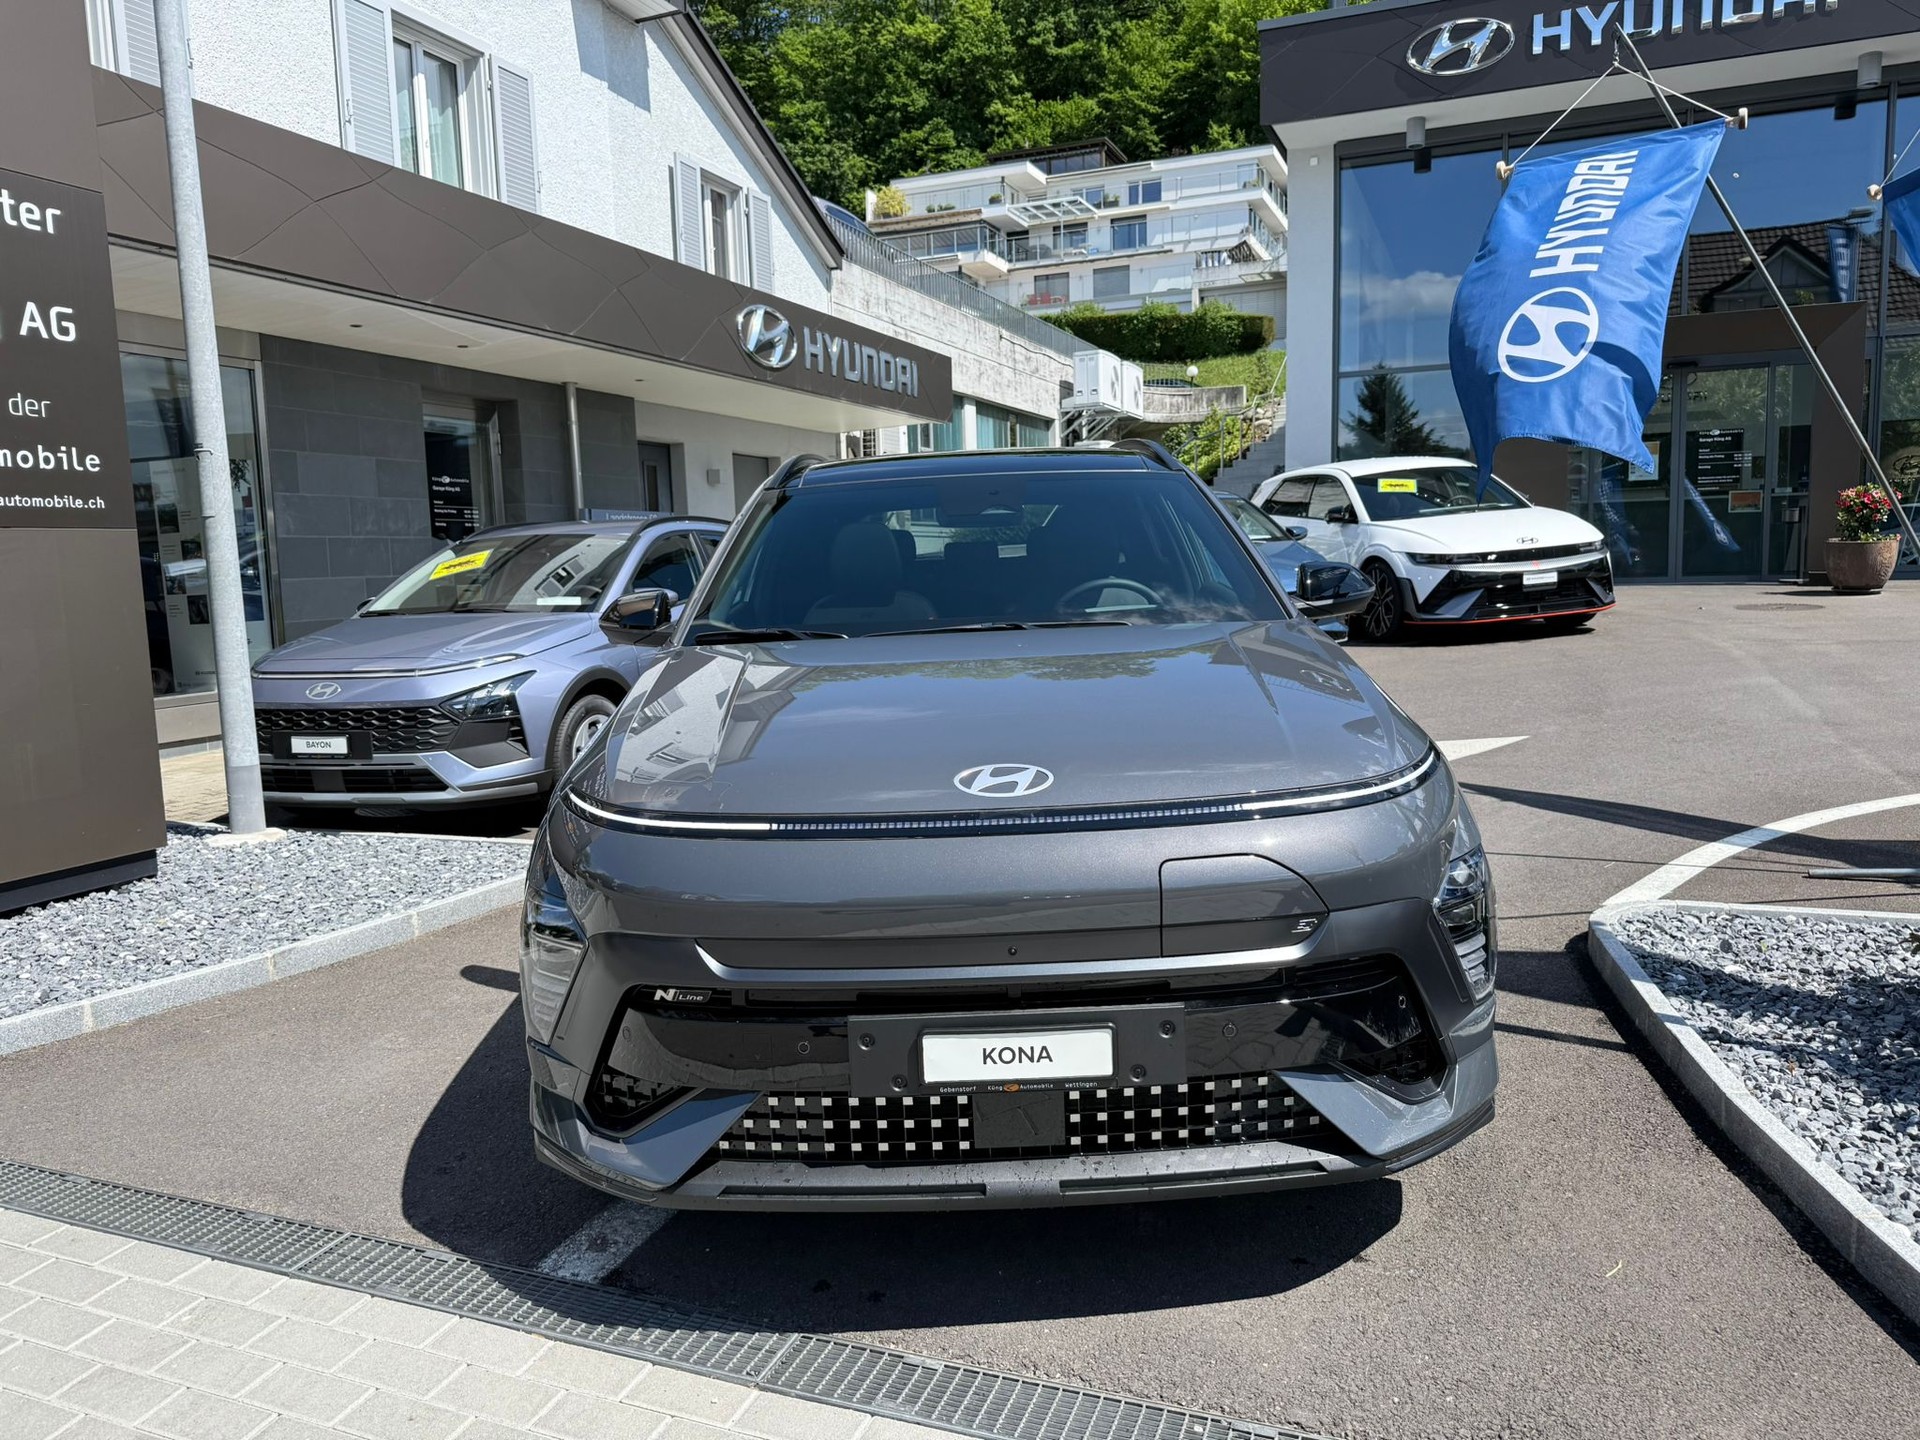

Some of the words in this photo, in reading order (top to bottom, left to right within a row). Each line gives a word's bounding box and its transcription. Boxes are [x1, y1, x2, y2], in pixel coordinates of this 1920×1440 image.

[1532, 0, 1838, 54] HYUND
[0, 188, 61, 234] ter
[1529, 150, 1639, 278] HYUNDAI
[19, 301, 76, 342] AG
[803, 325, 918, 398] HYUNDAI
[8, 392, 51, 418] der
[306, 741, 332, 749] BAYON
[982, 1045, 1053, 1065] KONA
